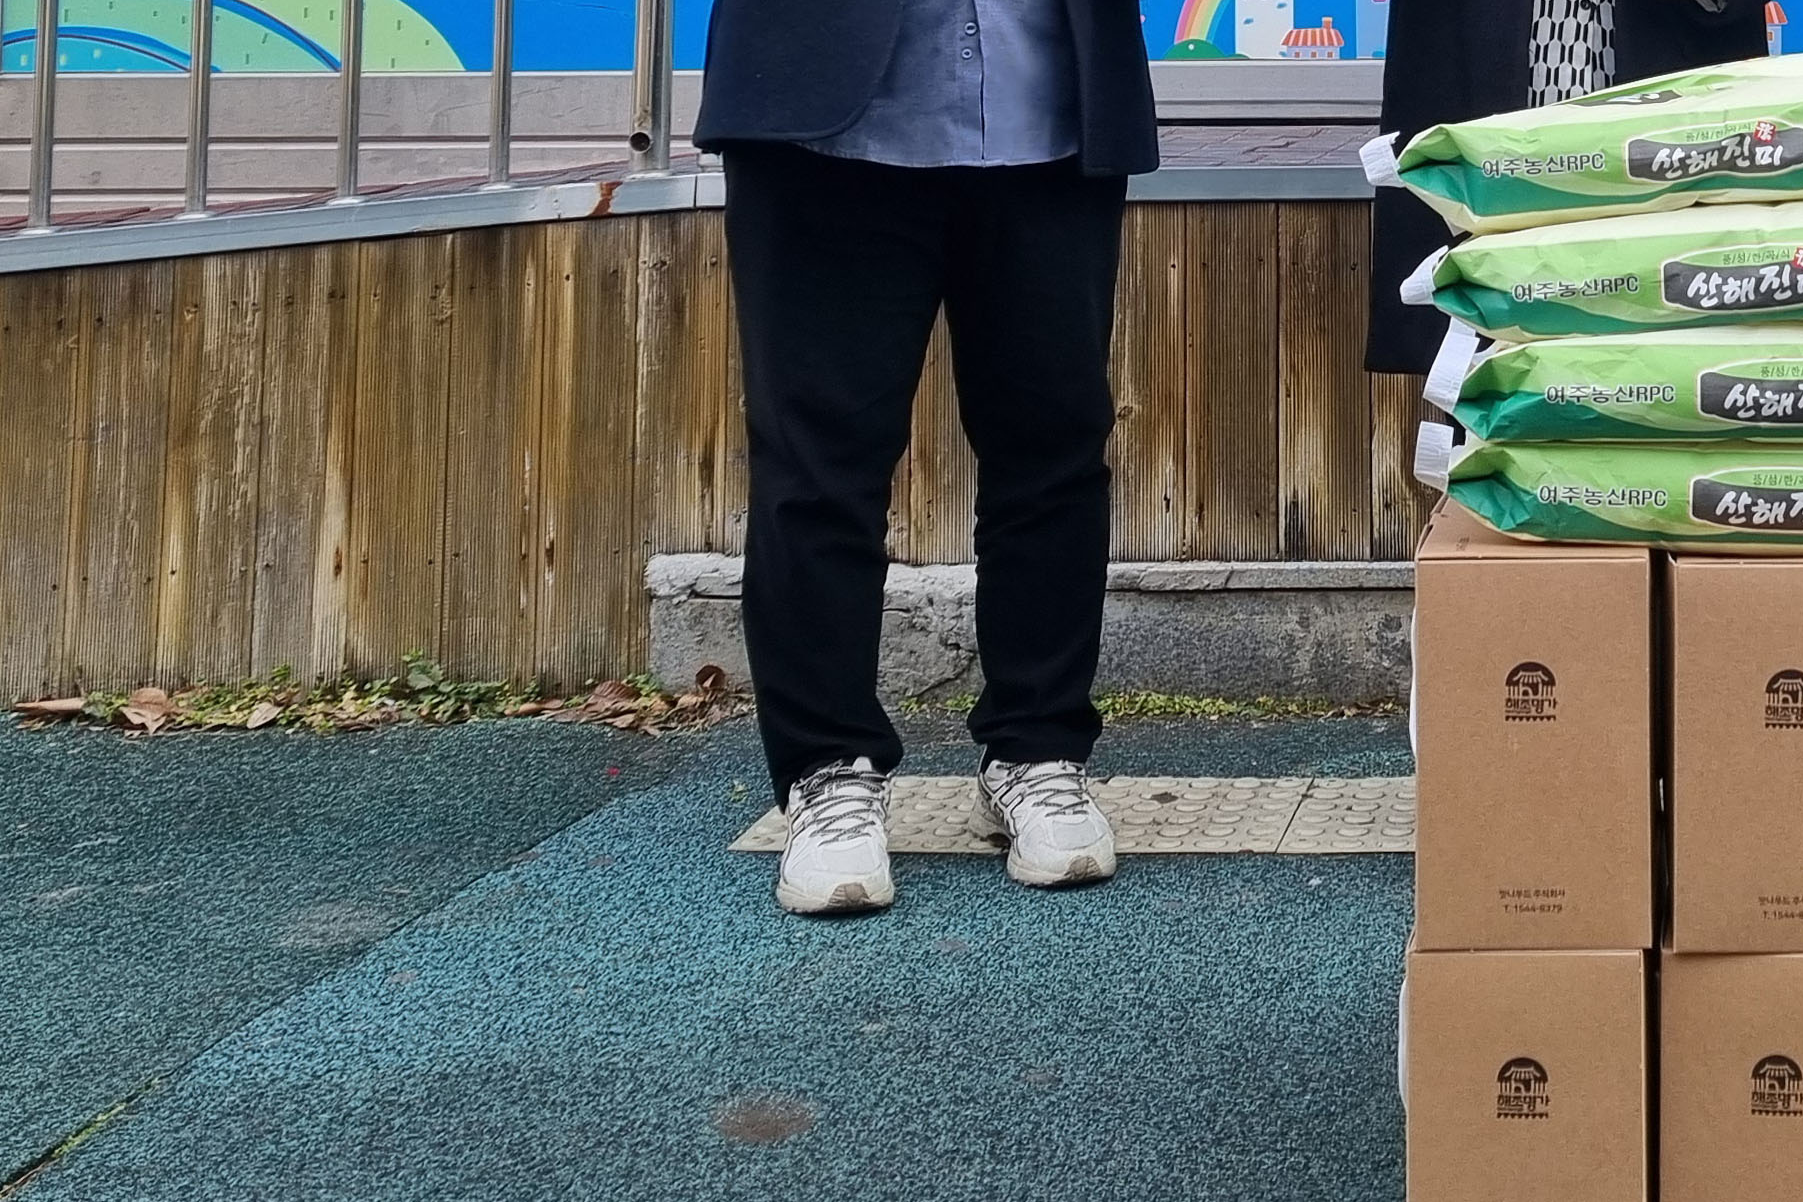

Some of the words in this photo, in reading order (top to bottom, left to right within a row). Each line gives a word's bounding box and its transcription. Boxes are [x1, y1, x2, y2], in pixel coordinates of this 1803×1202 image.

[1482, 153, 1604, 177] 여주농산RPC
[1652, 135, 1783, 179] 산해진미
[1513, 275, 1639, 302] 여주농산RPC
[1545, 385, 1675, 405] 여주농산RPC
[1538, 484, 1667, 508] 여주농산RPC
